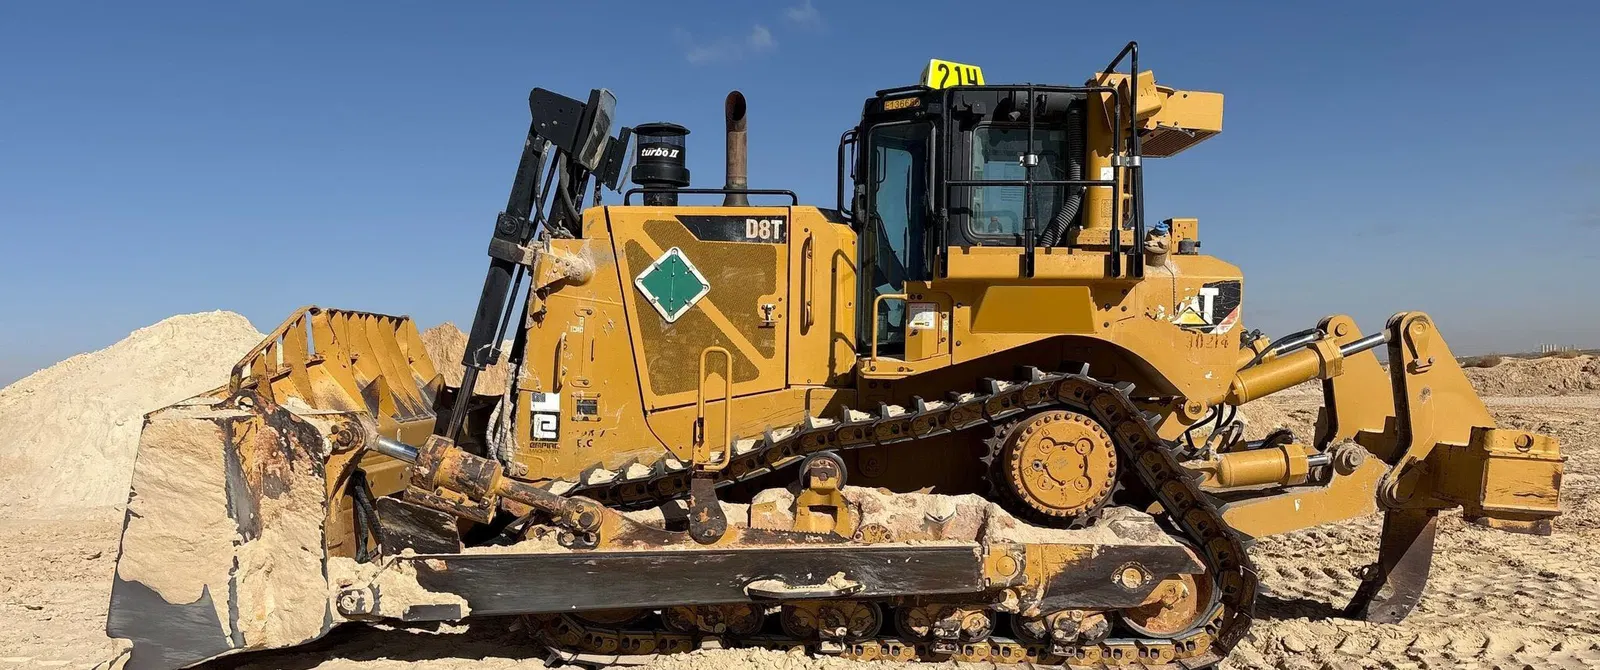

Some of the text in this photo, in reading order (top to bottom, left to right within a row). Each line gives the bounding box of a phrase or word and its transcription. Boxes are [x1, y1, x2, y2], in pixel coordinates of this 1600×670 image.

[938, 63, 978, 89] 214
[641, 147, 679, 158] turbo II
[745, 218, 783, 240] D8T
